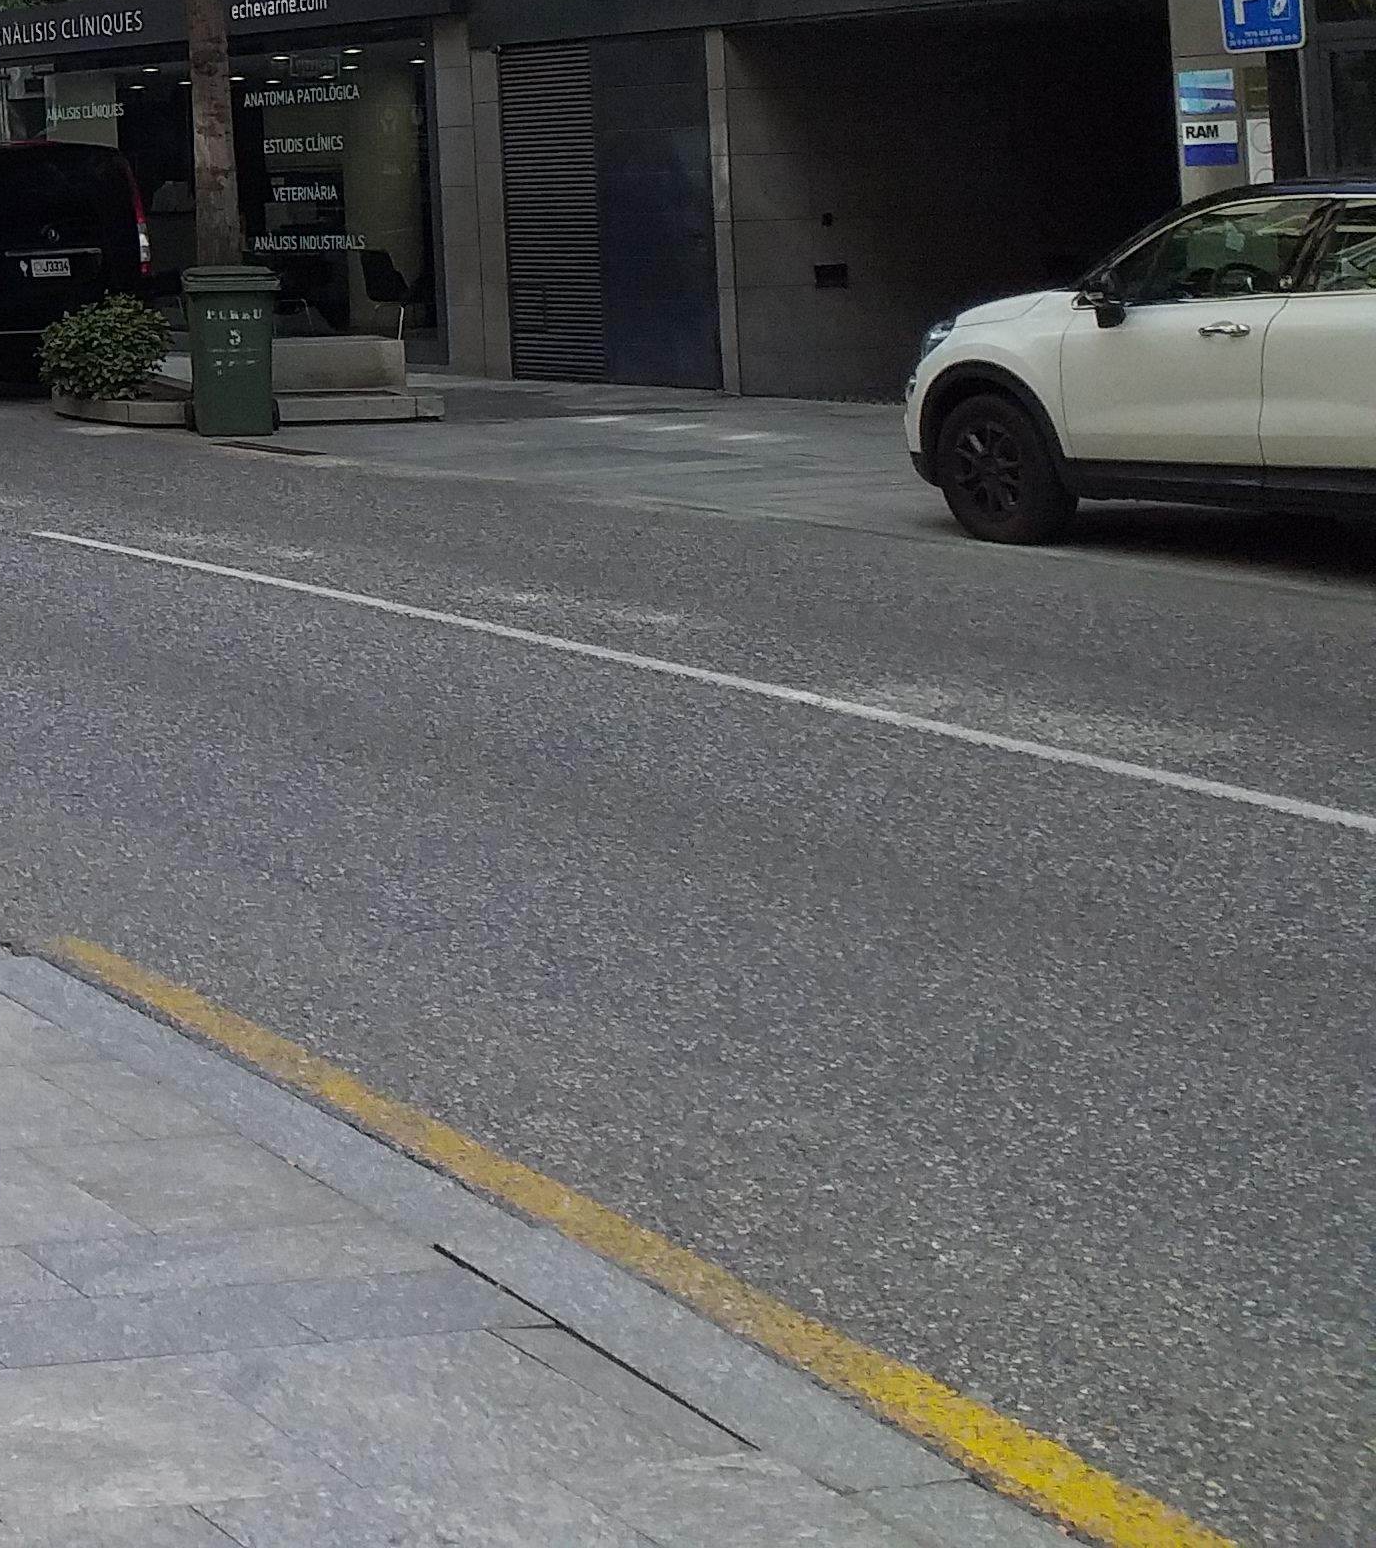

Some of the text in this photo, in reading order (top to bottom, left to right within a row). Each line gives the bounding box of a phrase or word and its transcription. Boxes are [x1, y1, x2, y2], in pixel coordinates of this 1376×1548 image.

[61, 9, 143, 39] CLÍNIQUES
[243, 82, 361, 108] ANATOMIA PATOLÒGICA
[1185, 125, 1220, 140] RAM
[263, 133, 344, 154] ESTUDIS CLÍNICS
[272, 181, 338, 201] VETERINÀRIA
[254, 230, 366, 250] ANÀLISIS INDUSTRIALS
